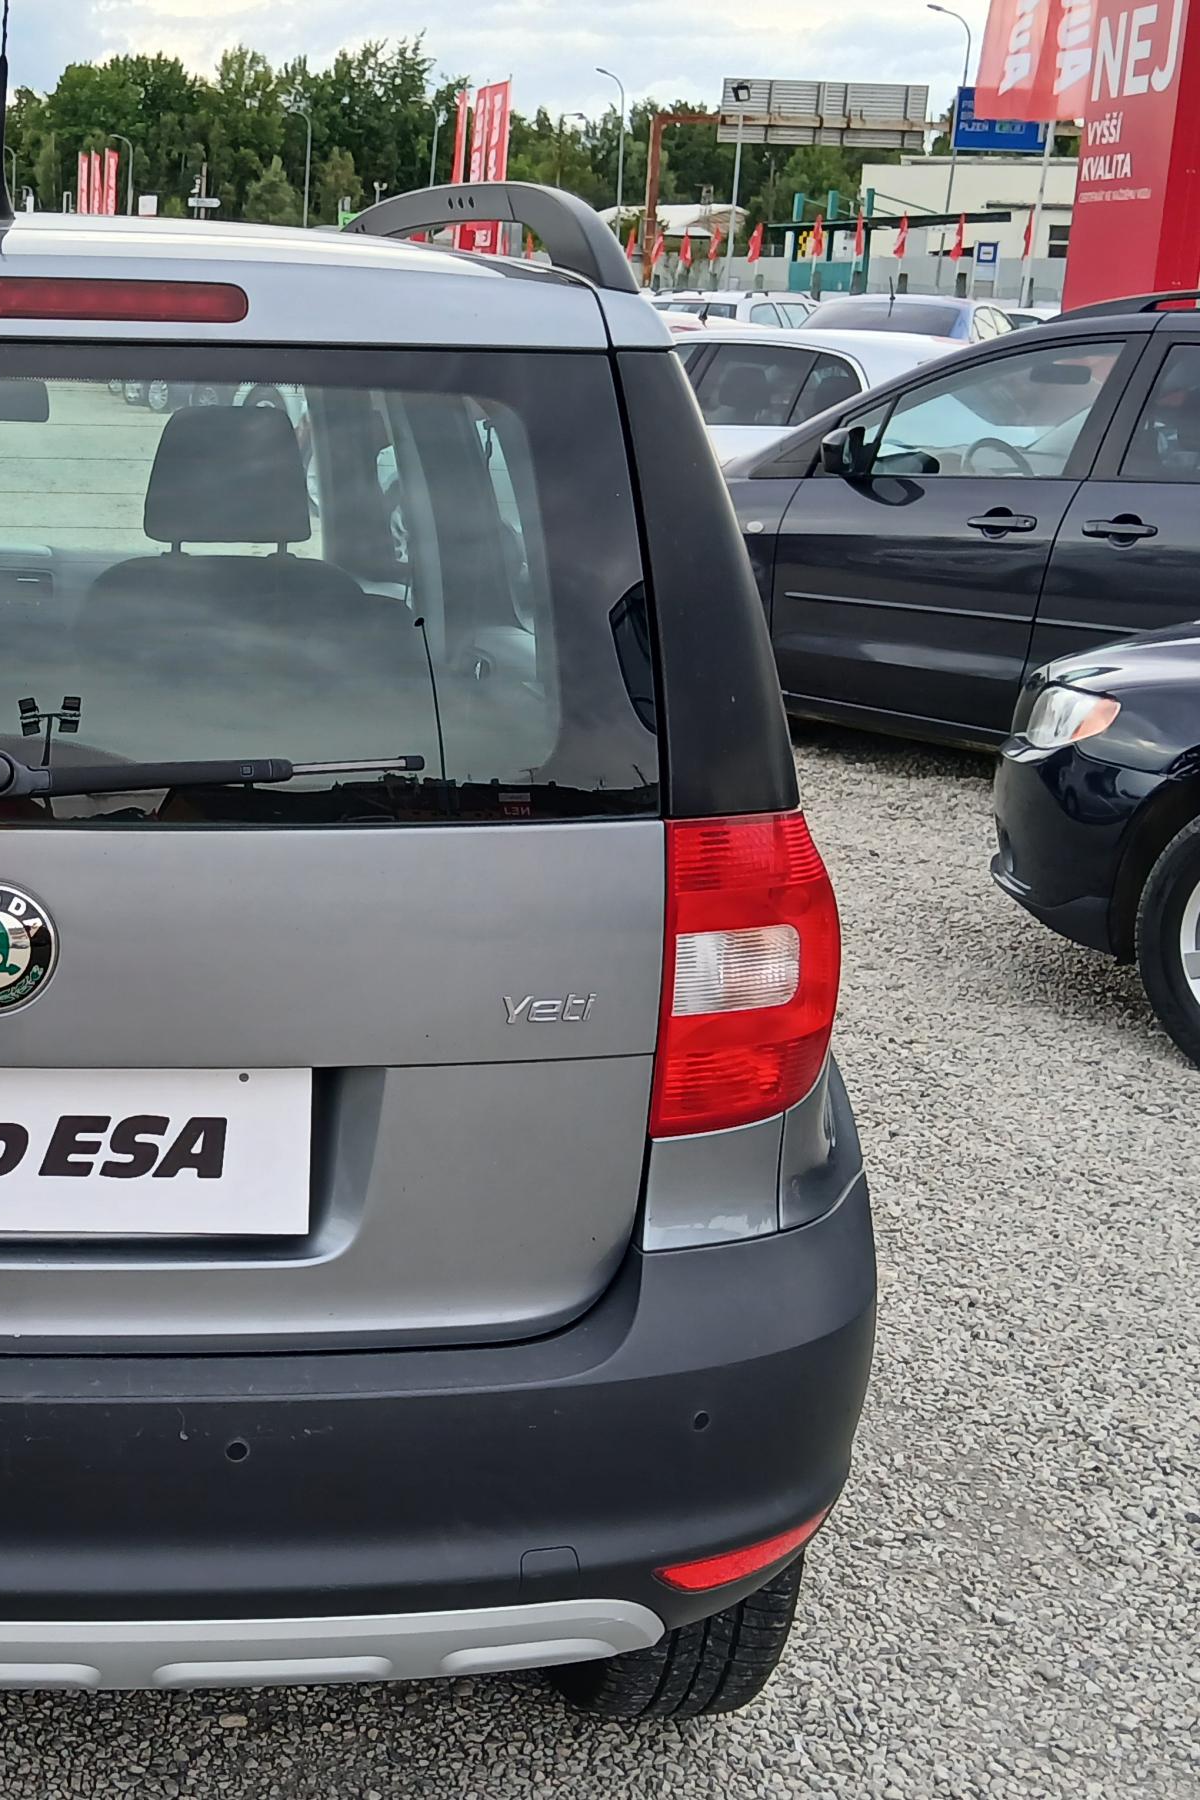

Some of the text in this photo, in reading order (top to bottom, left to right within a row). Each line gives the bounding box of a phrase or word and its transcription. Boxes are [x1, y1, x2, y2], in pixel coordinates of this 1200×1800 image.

[1091, 0, 1184, 102] NEJ
[1087, 112, 1124, 147] VYŠŠÍ
[1081, 153, 1132, 182] KVALITA
[502, 993, 598, 1024] Yeti
[37, 1114, 229, 1179] ESA
